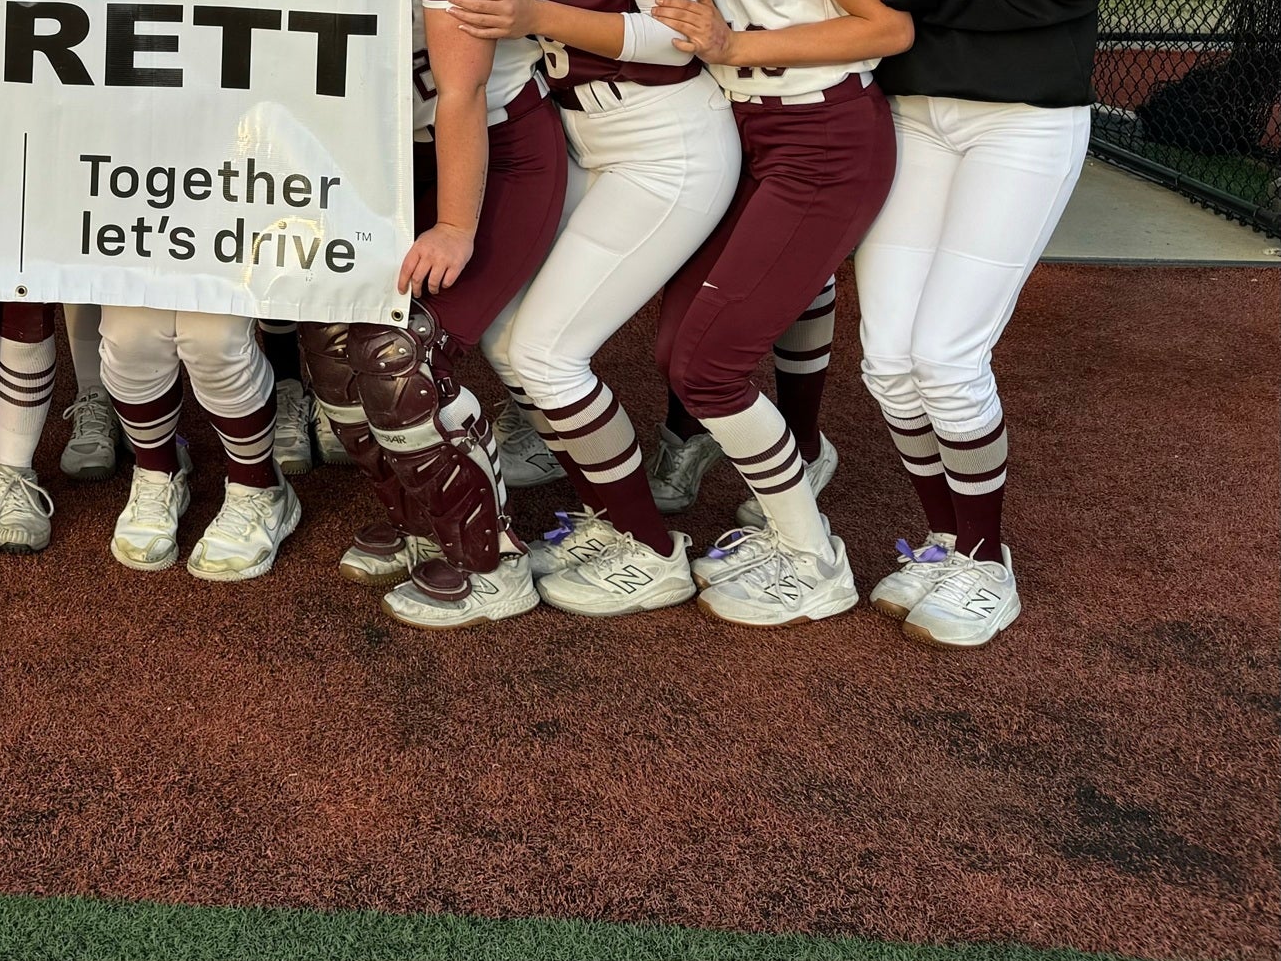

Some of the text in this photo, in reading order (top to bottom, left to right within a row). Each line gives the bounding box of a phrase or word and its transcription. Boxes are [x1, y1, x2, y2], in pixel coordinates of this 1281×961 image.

[80, 154, 341, 209] Together
[81, 210, 196, 260] let's
[214, 217, 356, 273] drive
